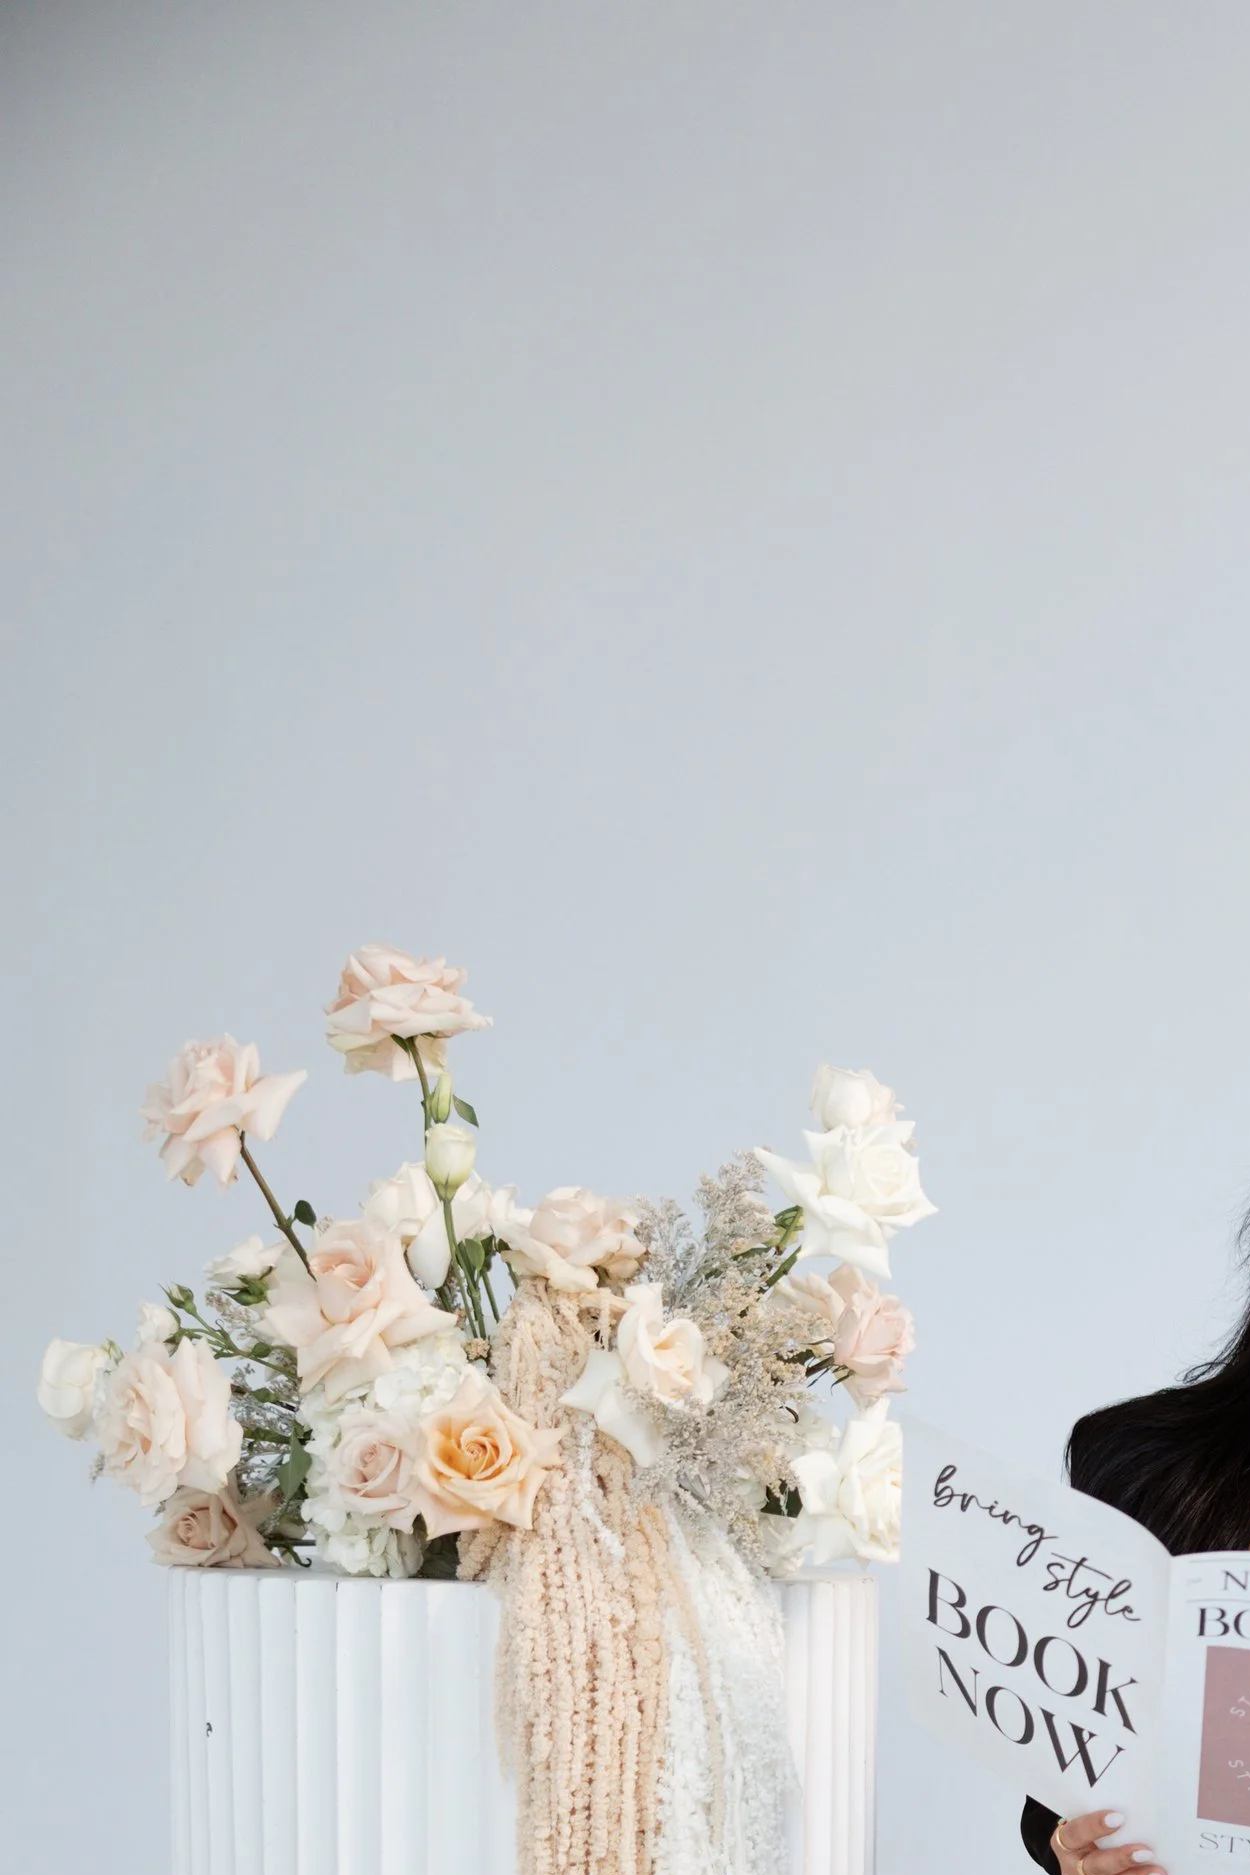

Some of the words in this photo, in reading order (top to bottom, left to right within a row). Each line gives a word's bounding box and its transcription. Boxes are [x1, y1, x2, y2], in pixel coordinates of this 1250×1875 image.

[933, 1464, 1059, 1566] bring
[1043, 1552, 1141, 1628] style
[925, 1567, 1139, 1736] BOOK
[934, 1645, 1127, 1788] NOW
